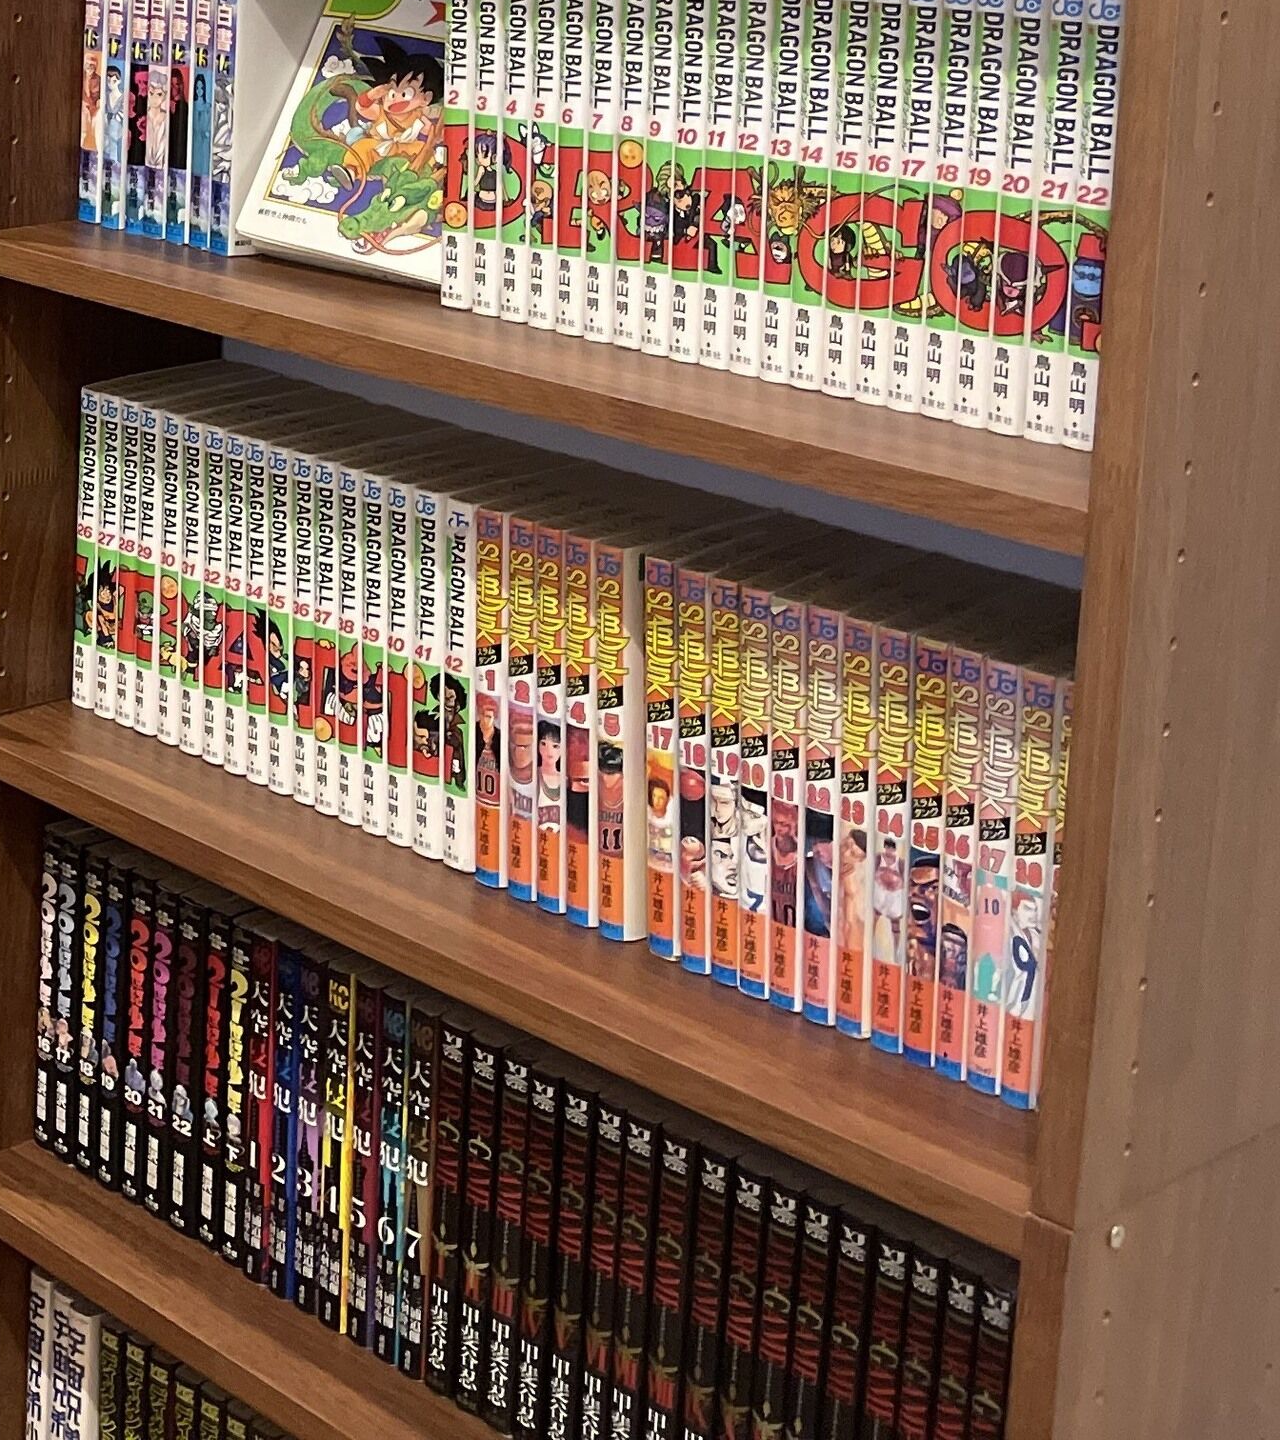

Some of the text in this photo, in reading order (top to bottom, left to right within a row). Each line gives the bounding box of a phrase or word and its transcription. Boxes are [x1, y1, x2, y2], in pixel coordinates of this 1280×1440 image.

[682, 72, 701, 123] BALL
[744, 76, 764, 128] BALL
[807, 88, 829, 140] BALL
[1077, 24, 1120, 206] DRAGON 22
[677, 128, 697, 145] 10
[738, 133, 759, 151] 12
[800, 146, 823, 163] 14
[993, 18, 1040, 400] DRAGON BALL 20 鳥山明
[673, 285, 686, 332] 鳥山明
[733, 292, 747, 341] 鳥山明
[794, 308, 810, 358] 鳥山明
[485, 670, 495, 691] 1
[603, 712, 620, 737] 5
[651, 724, 673, 750] 17
[404, 1228, 423, 1259] 7
